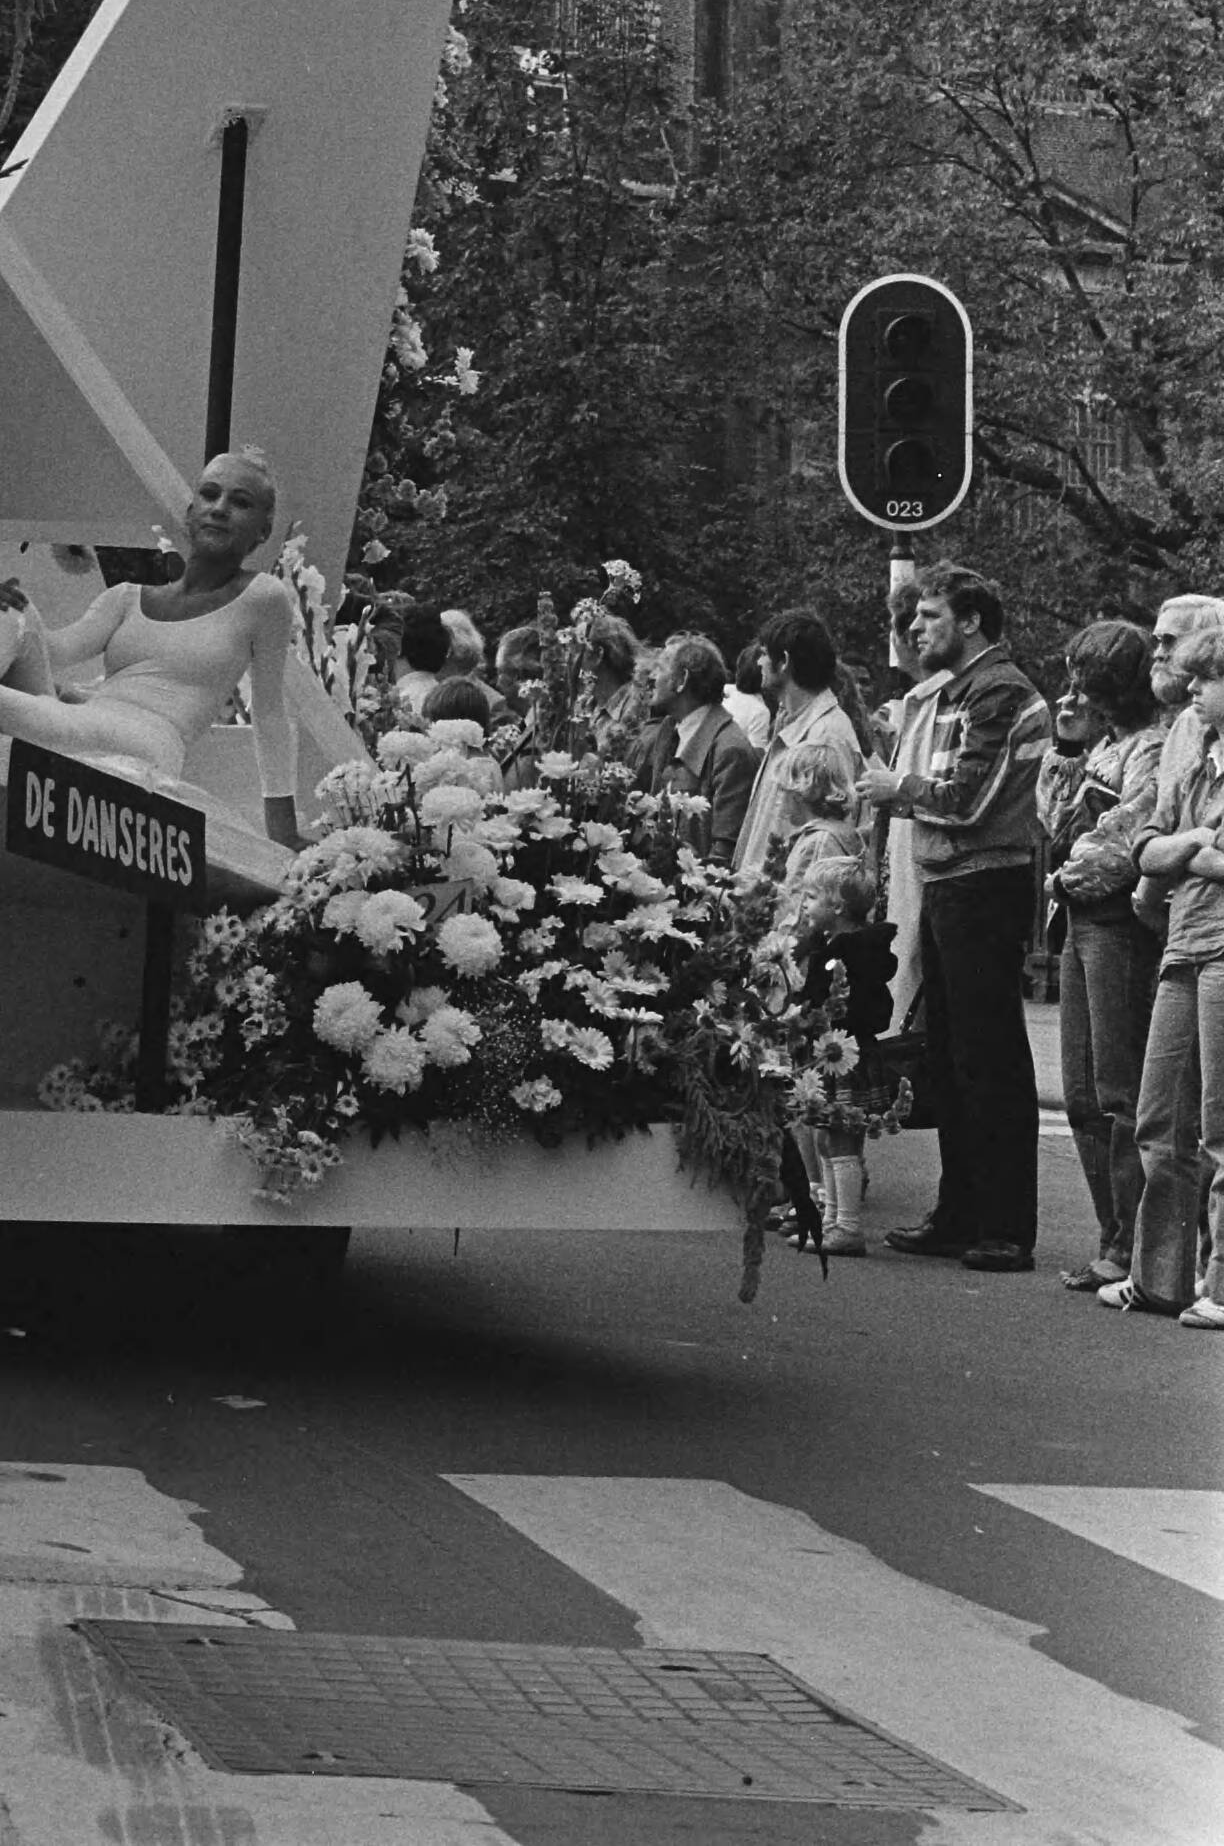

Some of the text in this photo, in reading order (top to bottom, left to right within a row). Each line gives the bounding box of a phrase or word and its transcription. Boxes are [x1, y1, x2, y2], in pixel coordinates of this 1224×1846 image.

[886, 500, 923, 517] 023
[25, 771, 193, 887] DE DANSERES
